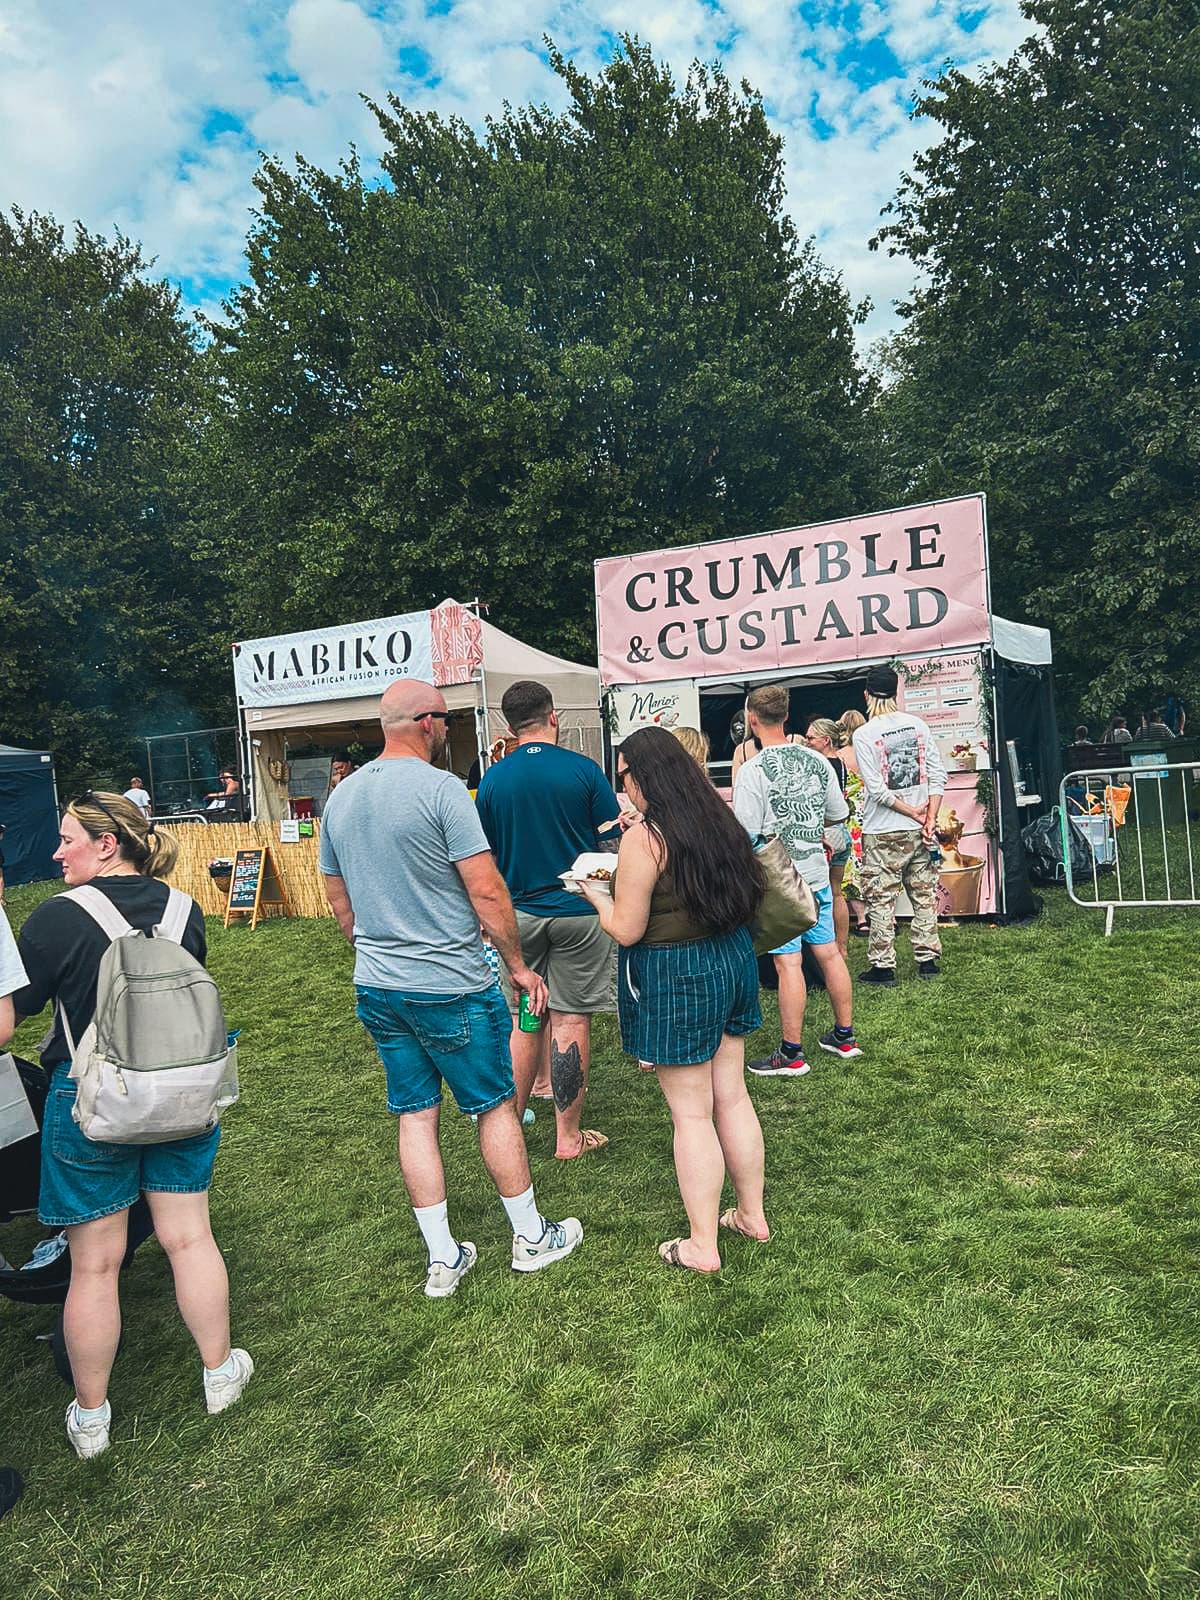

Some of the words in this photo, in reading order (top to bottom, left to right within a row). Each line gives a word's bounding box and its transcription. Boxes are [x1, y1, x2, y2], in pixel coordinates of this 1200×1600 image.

[626, 523, 946, 613] CRUMBLE
[253, 630, 412, 683] MABIKO
[947, 657, 978, 668] MENU
[311, 675, 345, 686] AFRICAN
[349, 670, 380, 681] FUSION
[384, 666, 409, 676] FOOD
